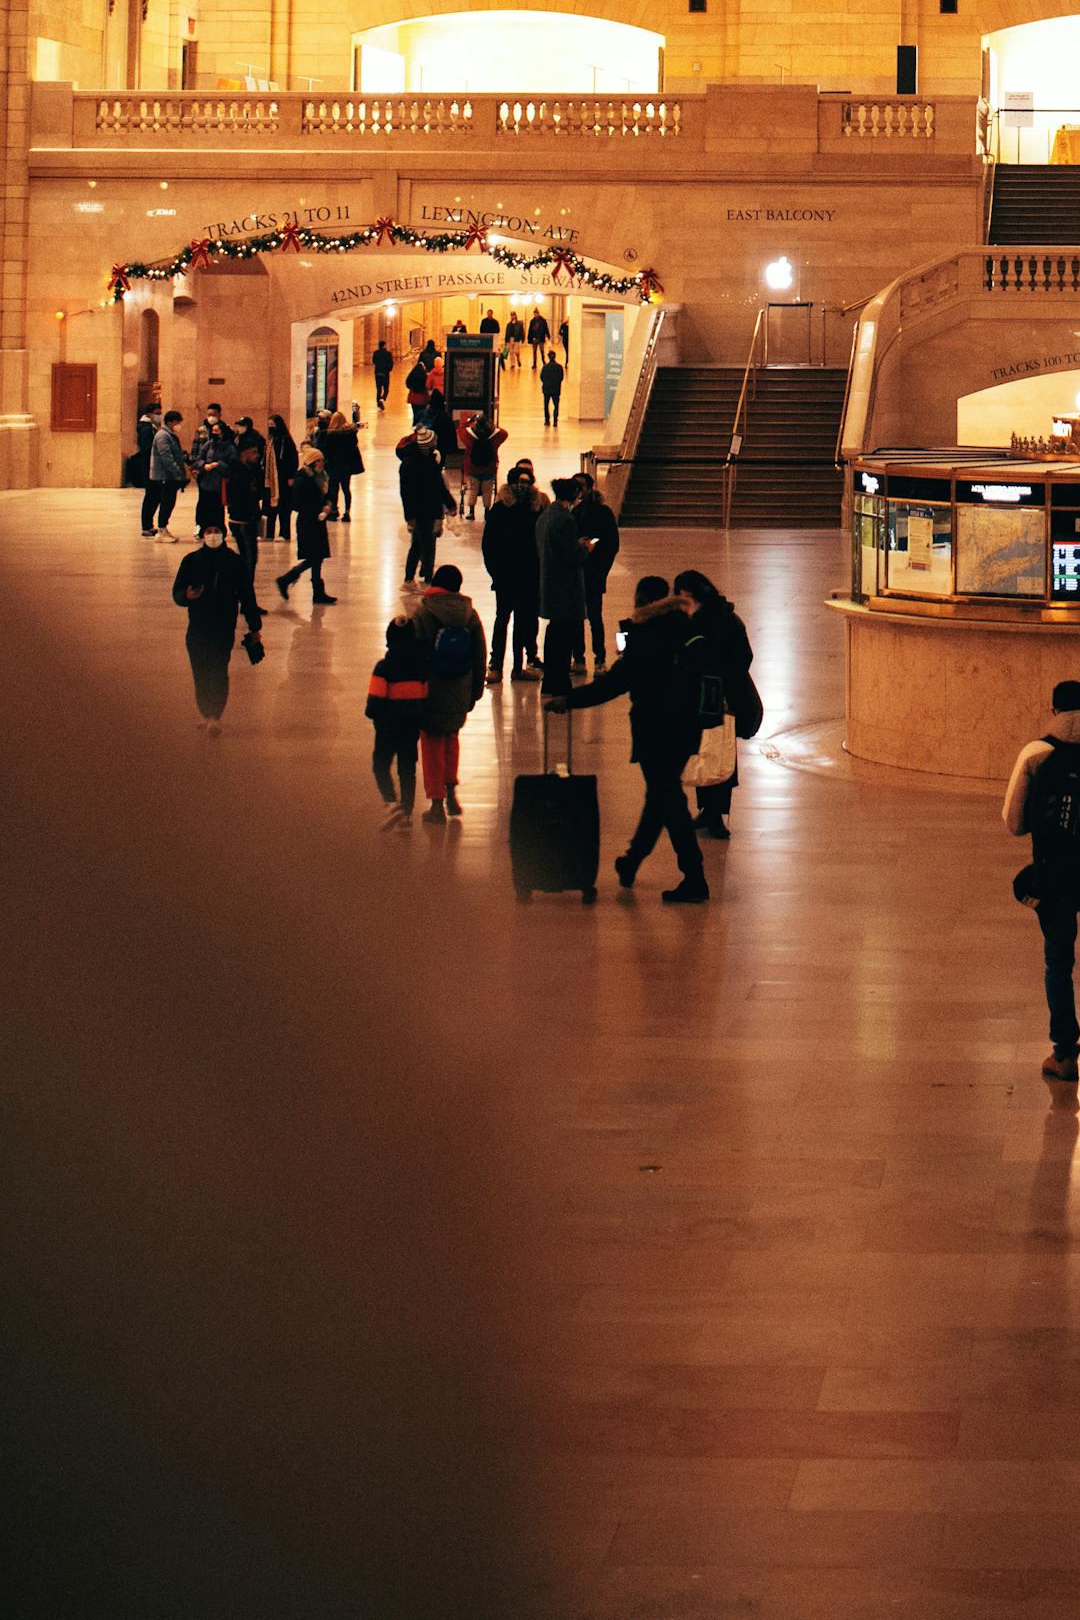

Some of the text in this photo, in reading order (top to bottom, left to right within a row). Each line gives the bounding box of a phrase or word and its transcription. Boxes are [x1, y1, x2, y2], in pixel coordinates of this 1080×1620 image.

[204, 206, 350, 239] TRACKS 21 TO 11
[422, 206, 580, 245] LEXINGTON AVE
[727, 209, 836, 221] EAST BALCONY
[330, 272, 584, 303] 42ND STREET PASSAGE SUBWAY
[990, 358, 1041, 381] TRACKS
[1043, 355, 1063, 368] 100
